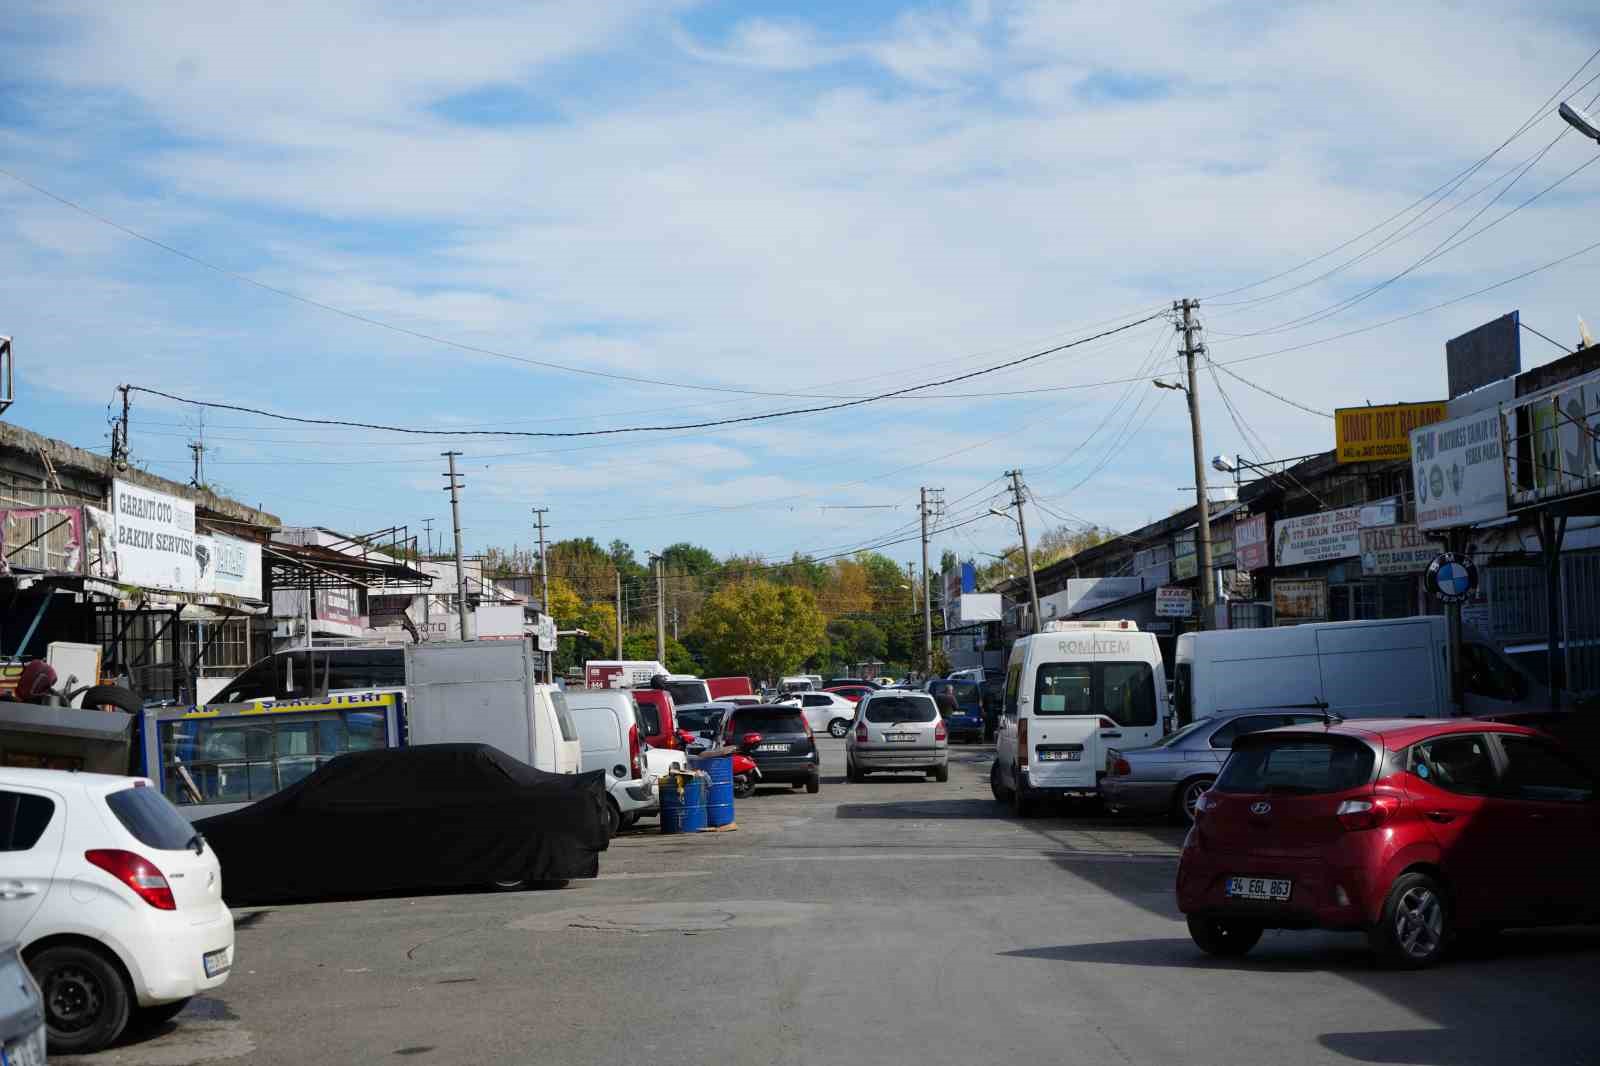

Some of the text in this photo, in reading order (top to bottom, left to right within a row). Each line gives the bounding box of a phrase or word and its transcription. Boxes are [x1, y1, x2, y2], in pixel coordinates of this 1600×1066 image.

[157, 501, 173, 523] OTO
[118, 526, 155, 550] BAKIM
[1058, 640, 1130, 655] ROMATEM
[1231, 878, 1243, 892] 34
[1270, 880, 1289, 895] 863
